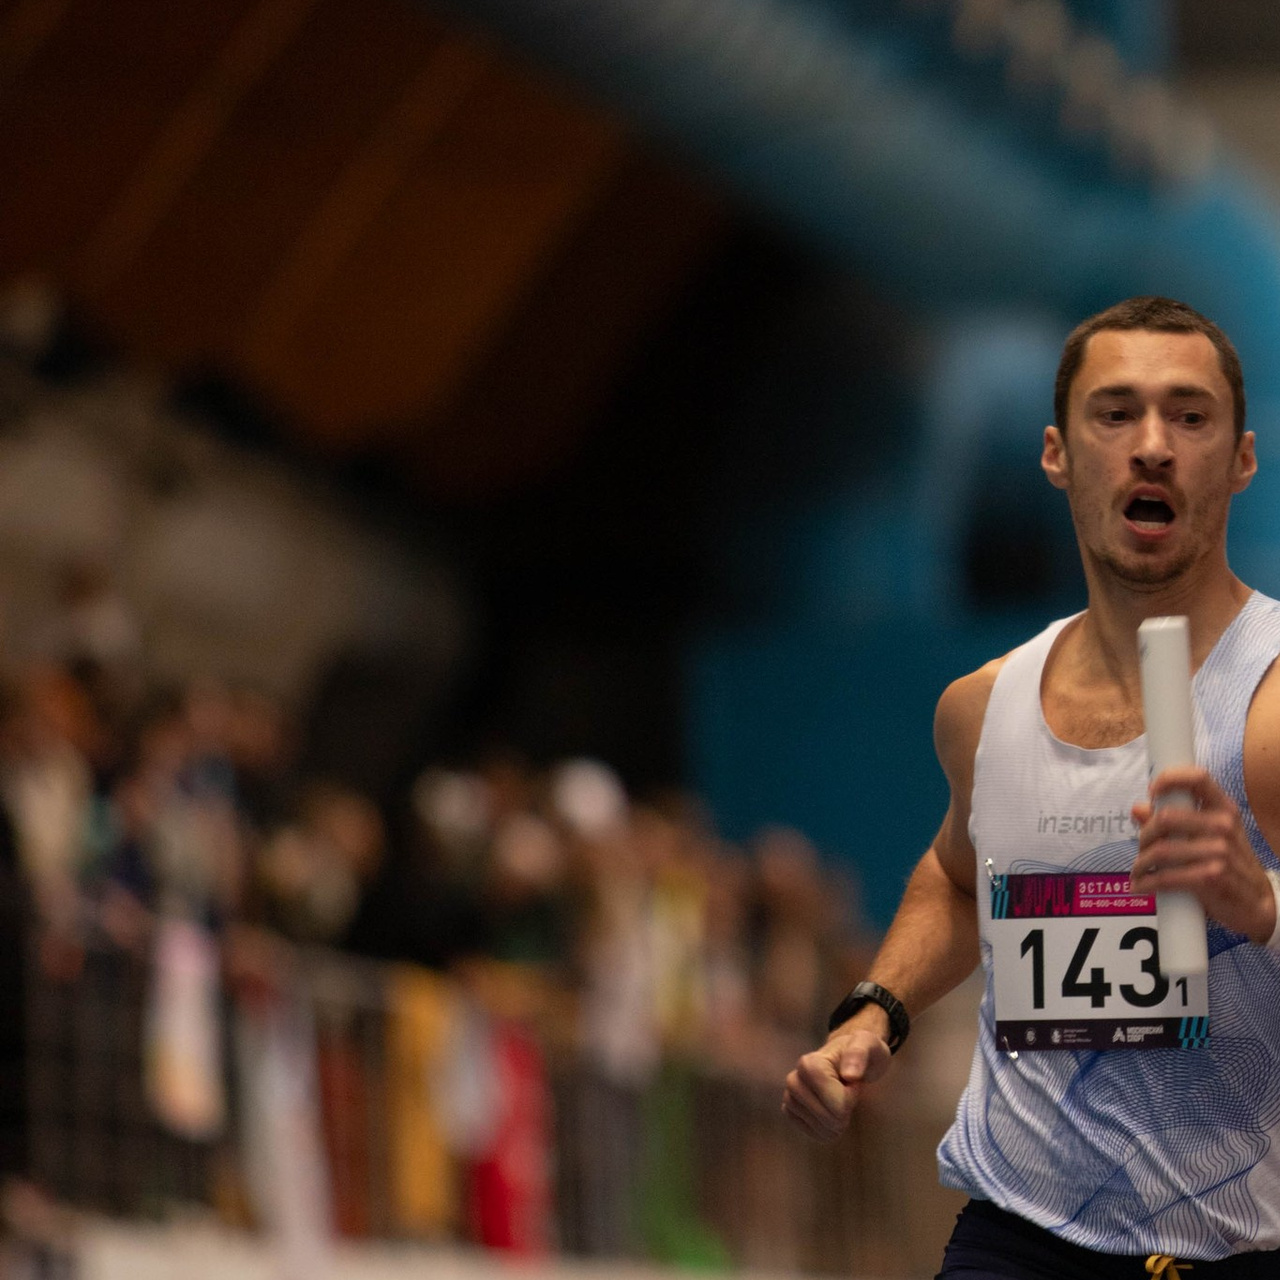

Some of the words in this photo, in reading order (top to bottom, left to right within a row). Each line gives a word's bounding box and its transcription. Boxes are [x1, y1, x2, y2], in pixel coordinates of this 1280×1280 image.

[1079, 881, 1131, 894] ЭСТАФЕ
[1020, 926, 1170, 1009] 143
[1175, 976, 1189, 1007] 1
